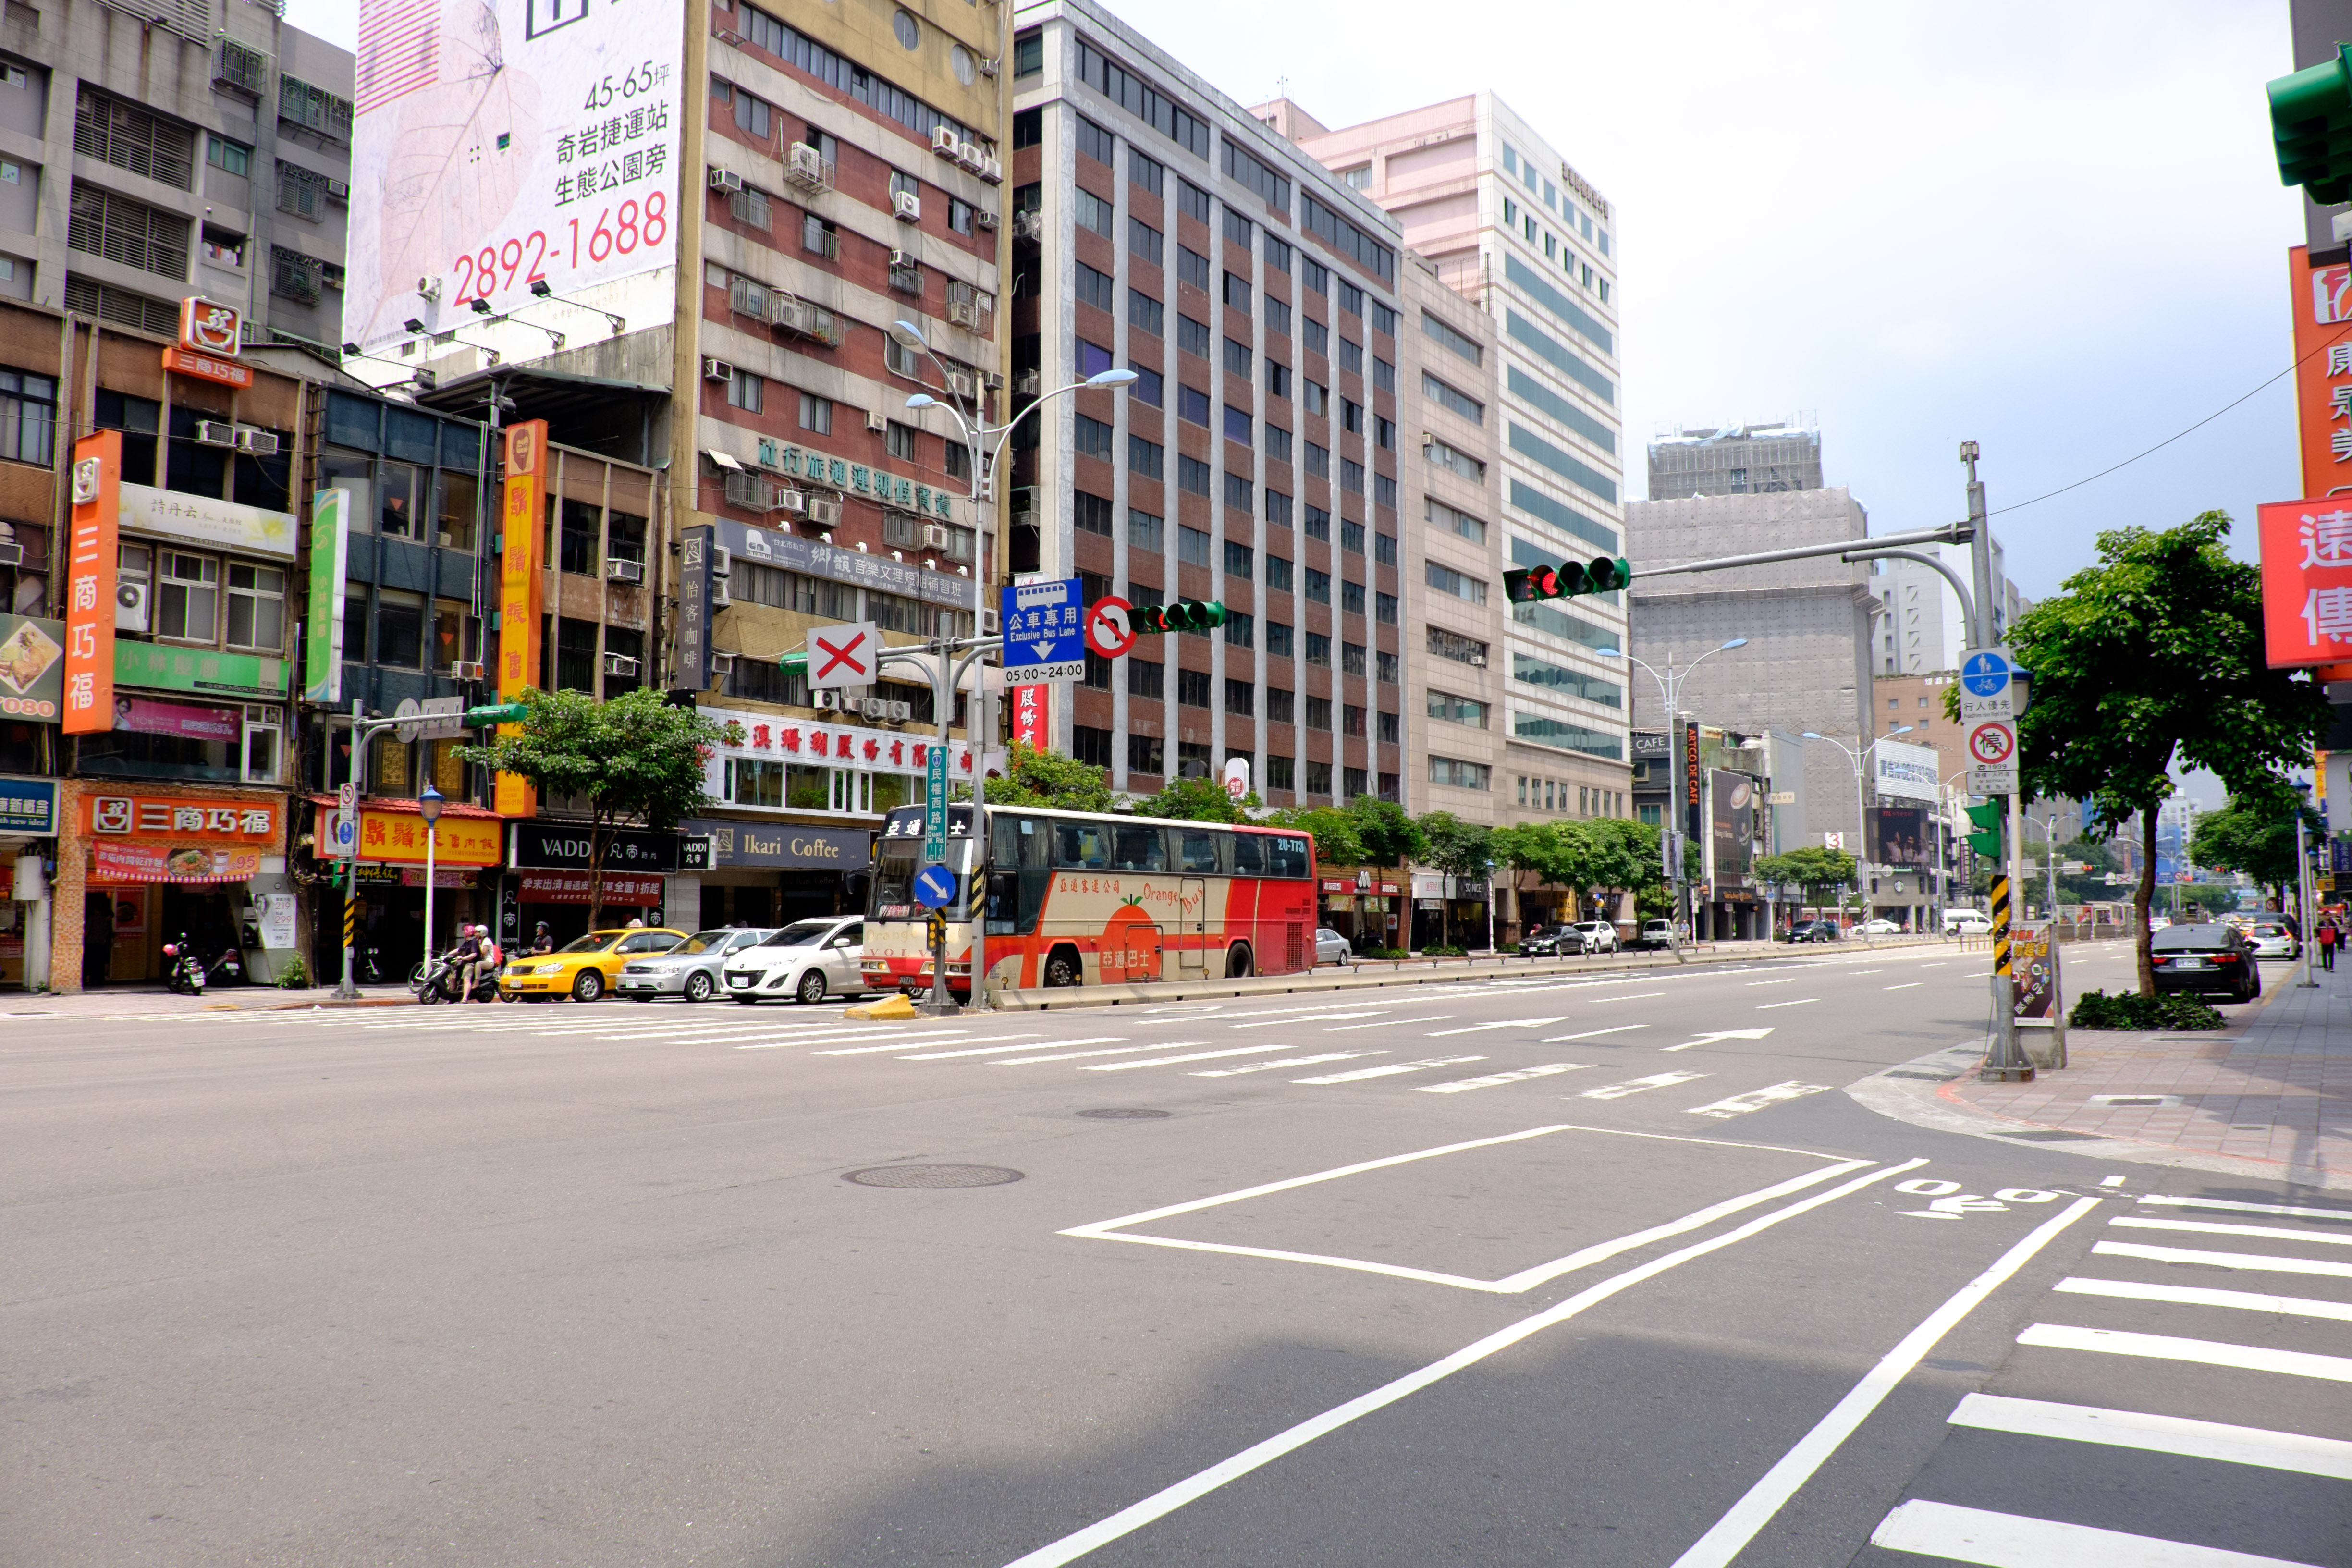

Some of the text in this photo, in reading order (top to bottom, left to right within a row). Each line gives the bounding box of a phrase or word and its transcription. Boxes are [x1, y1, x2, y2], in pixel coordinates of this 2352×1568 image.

[557, 100, 669, 164] 奇岩捷運站
[555, 144, 667, 207] 生態公園旁
[453, 191, 667, 307] 2892-1688
[178, 354, 245, 382] 三商巧福
[151, 499, 197, 519] 詩丹云
[774, 538, 806, 552] 台北市私立
[810, 546, 851, 575] 鄉韻
[855, 558, 962, 597] 音樂文理短期補習班
[70, 526, 98, 710] 三商巧福
[684, 580, 698, 669] 怡客咖啡
[1009, 607, 1077, 630] 公車專用
[1010, 626, 1075, 642] Exclusive Bus Lane
[1006, 664, 1082, 682] 05:00~24:00
[0, 696, 55, 717] 080
[1019, 684, 1037, 745] 股份有
[1964, 699, 2010, 711] 行人優先
[1636, 737, 1665, 749] CAFE
[1979, 733, 2002, 754] 停
[1688, 729, 1698, 804] ARTCO DE CAFE
[931, 769, 942, 823] 民權西路
[138, 803, 270, 834] 三商巧福
[885, 819, 966, 836] 亞通士
[449, 834, 496, 849] 魯肉飯
[542, 839, 592, 857] VADD
[682, 843, 707, 852] VADDI
[744, 834, 839, 858] Ikari Coffee
[1277, 837, 1305, 853] 2U-773
[1829, 833, 1840, 847] 3
[522, 878, 563, 890] 季末出清
[1060, 878, 1120, 894] 亞通客運公司
[1465, 884, 1482, 893] SO NICE
[1144, 882, 1203, 914] Orange Bus
[866, 929, 917, 942] Orange
[870, 948, 950, 958] VOLVO
[2014, 942, 2048, 956] 勿超速
[1102, 950, 1149, 968] 亞通巴士
